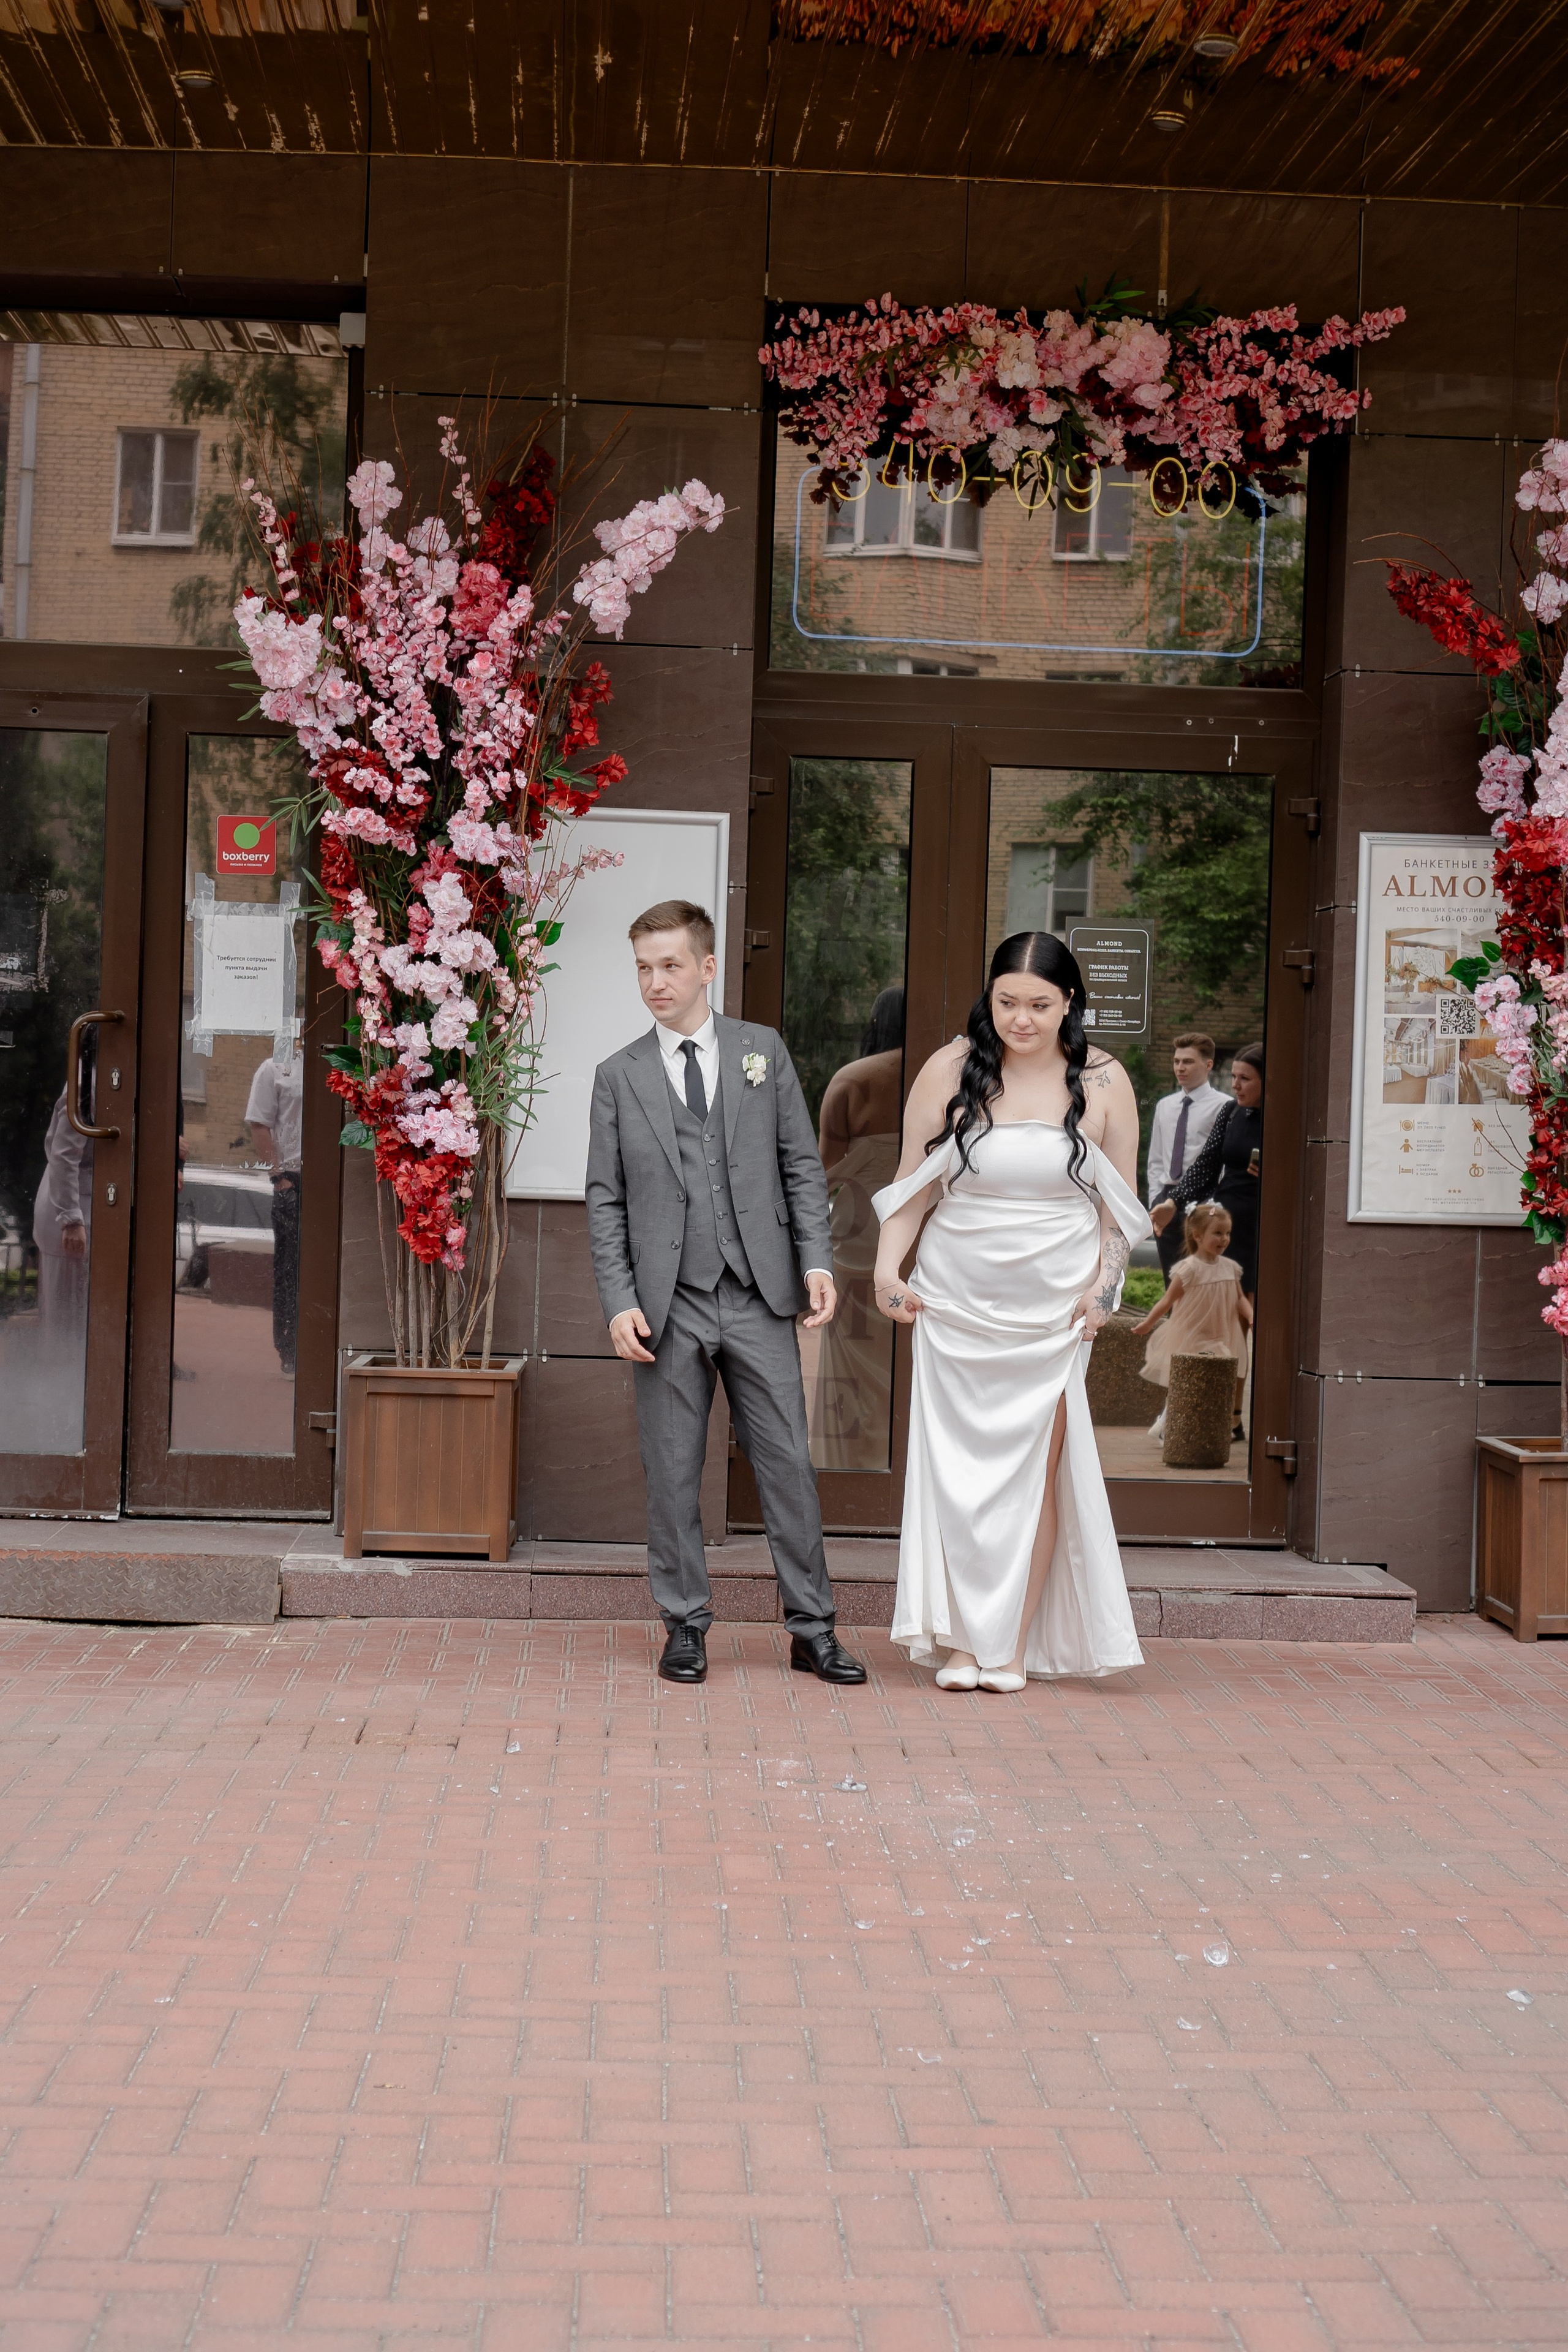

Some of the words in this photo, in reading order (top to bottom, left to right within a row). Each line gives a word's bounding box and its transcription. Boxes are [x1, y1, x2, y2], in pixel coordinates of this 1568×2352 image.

[809, 521, 1250, 637] БАНКЕТЫ
[222, 851, 270, 863] boxberry
[1404, 859, 1477, 869] БАНКЕТНЫЕ
